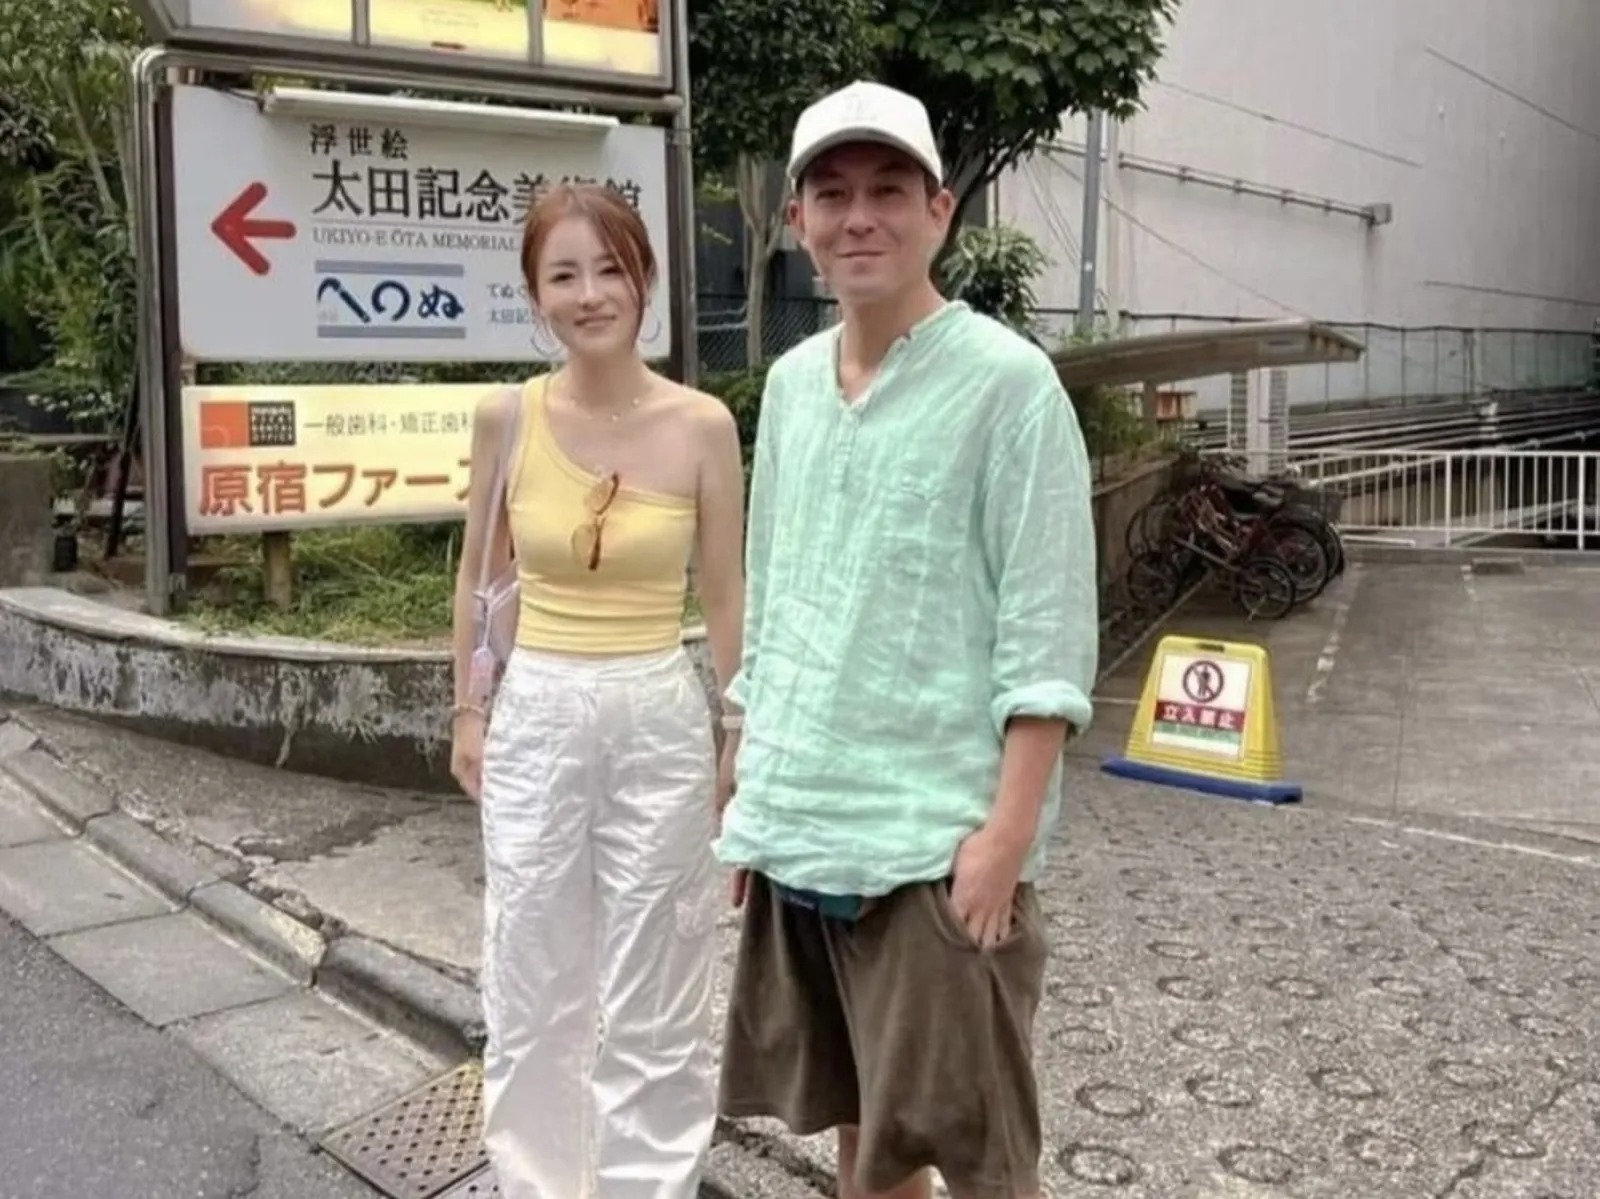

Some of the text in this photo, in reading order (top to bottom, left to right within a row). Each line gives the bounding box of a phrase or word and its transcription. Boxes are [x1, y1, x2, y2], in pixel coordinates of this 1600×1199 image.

[310, 124, 408, 159] 浮世絵
[313, 160, 641, 224] 太田記念美
[313, 227, 386, 246] UKIYO-E
[432, 232, 516, 251] MEMORIAL
